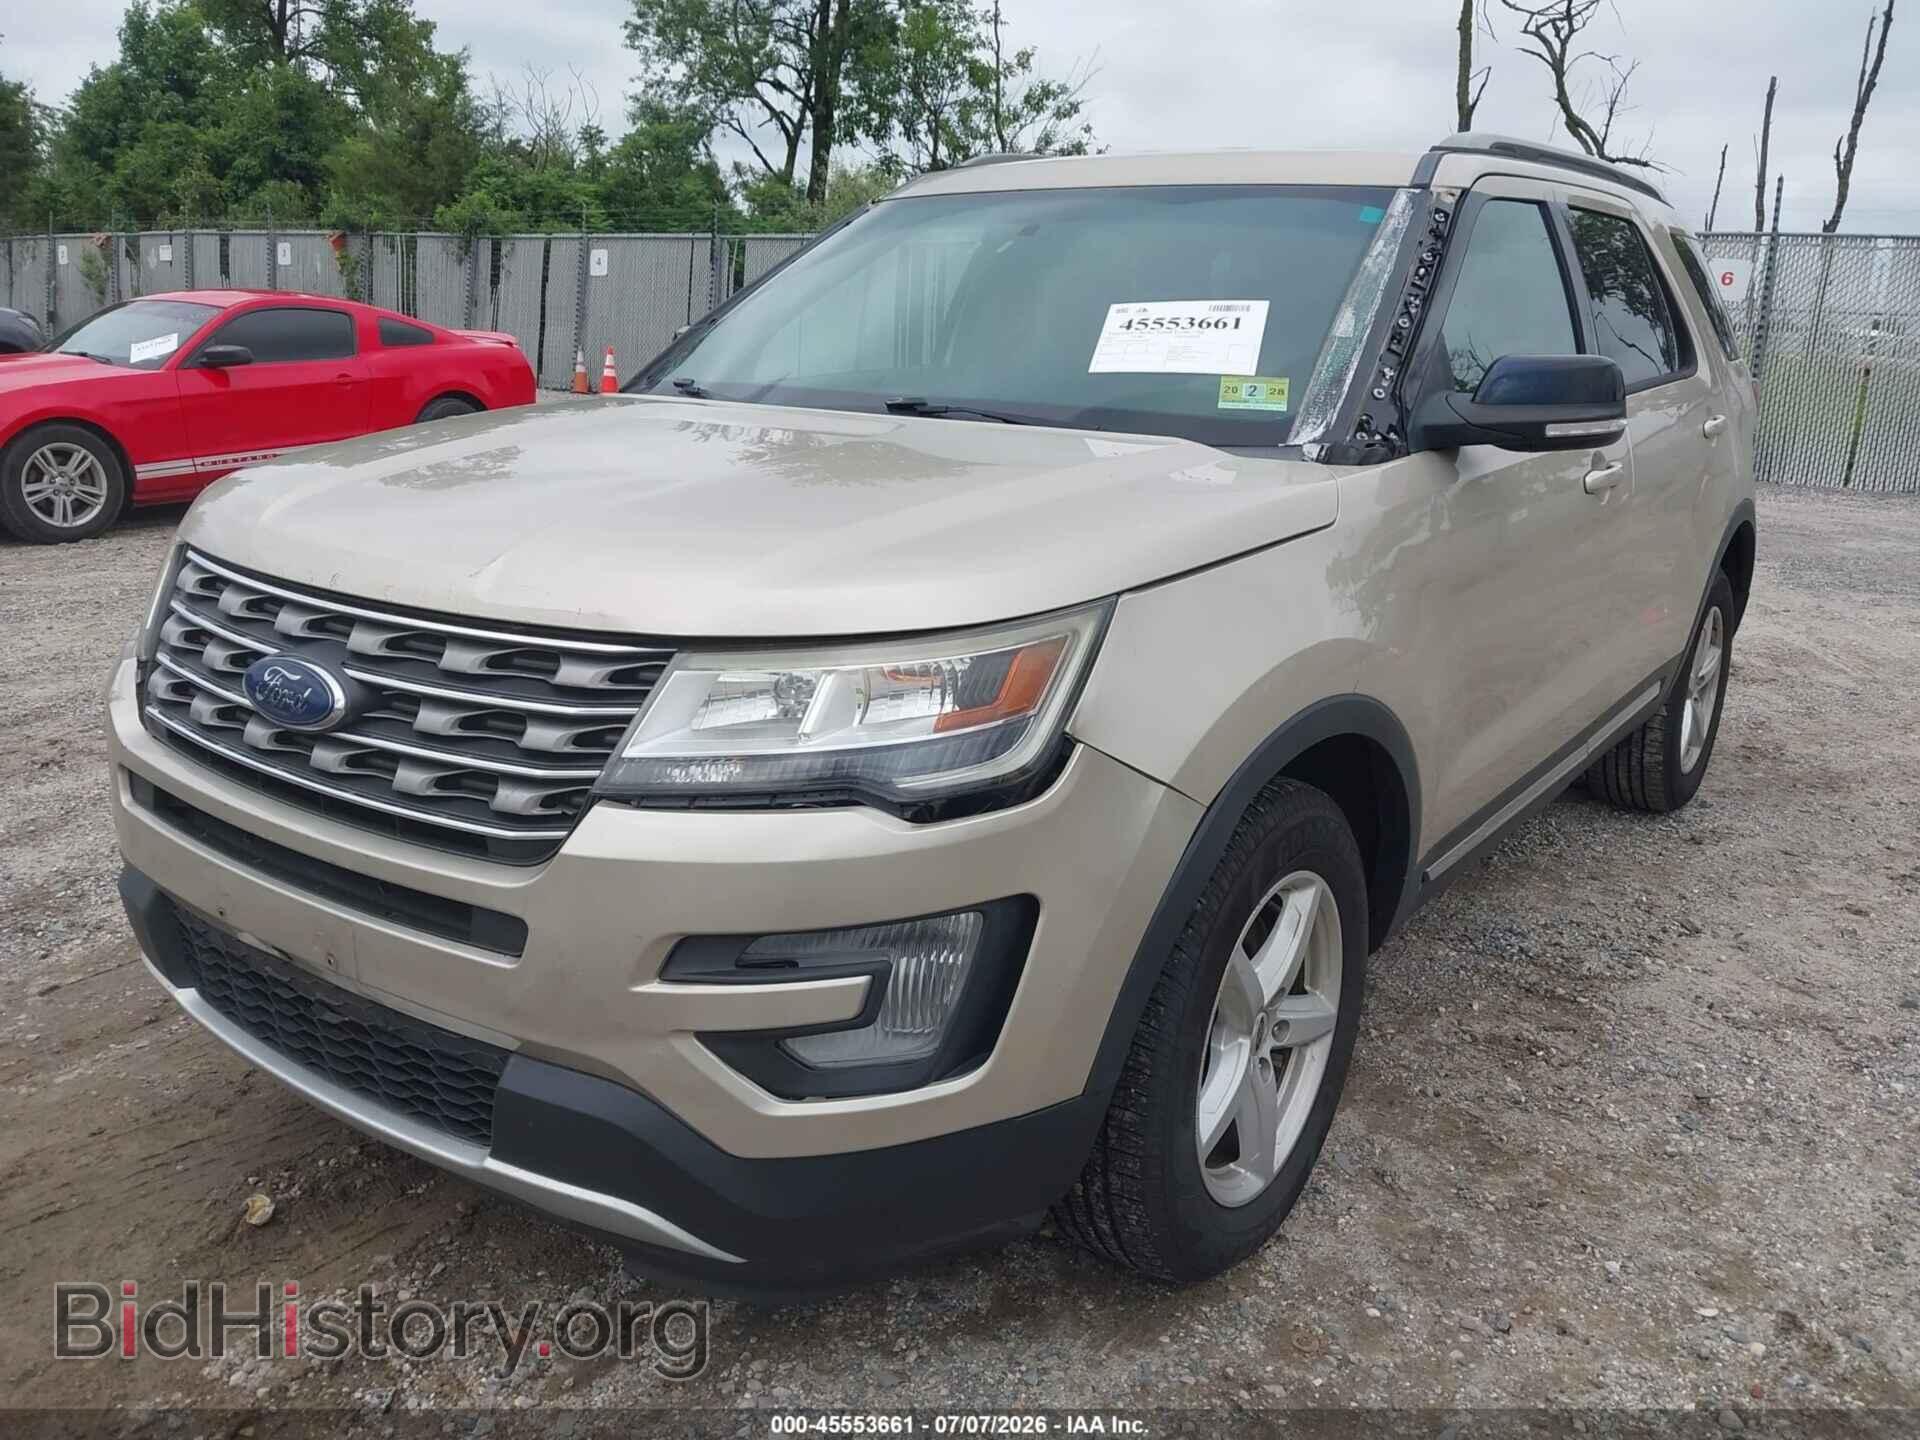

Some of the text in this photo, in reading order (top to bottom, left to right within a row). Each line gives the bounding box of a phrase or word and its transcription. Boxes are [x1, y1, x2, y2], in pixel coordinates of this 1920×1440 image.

[1721, 271, 1734, 286] 6
[1119, 317, 1241, 331] 45553661
[1223, 385, 1239, 394] 20
[1247, 384, 1257, 397] 2
[256, 666, 314, 713] Ford
